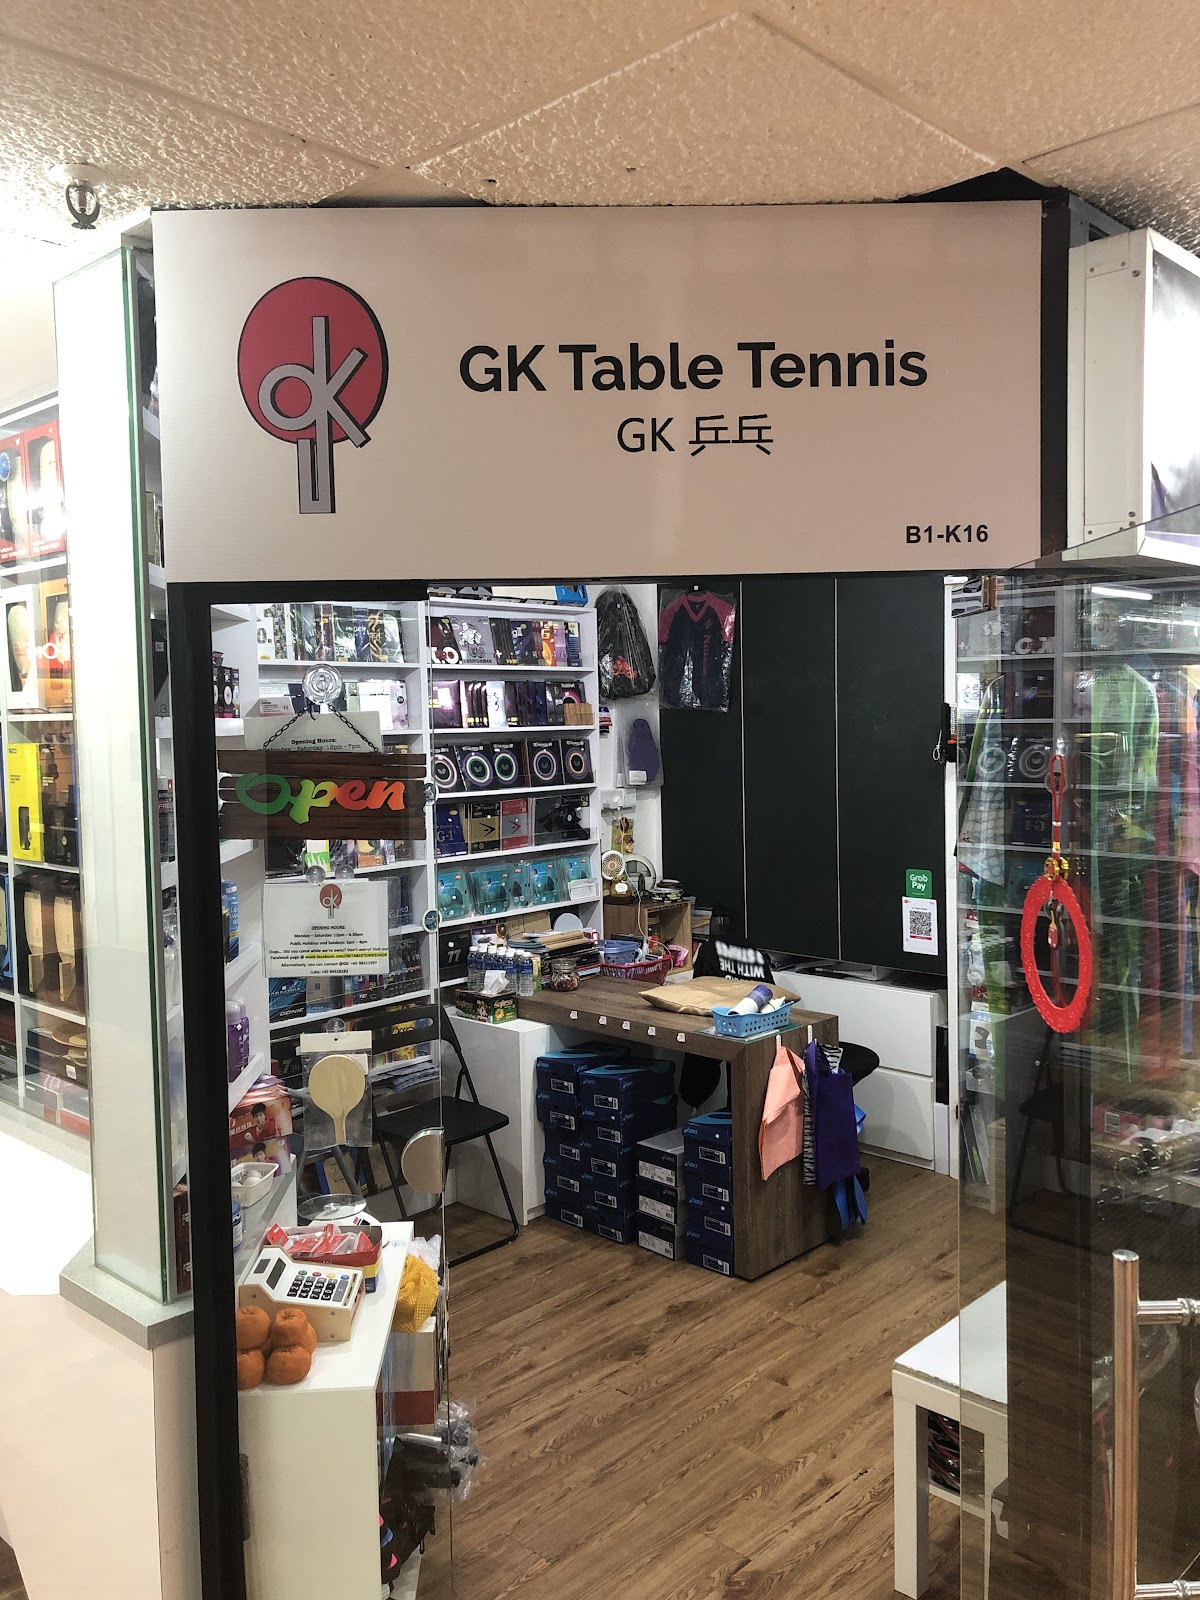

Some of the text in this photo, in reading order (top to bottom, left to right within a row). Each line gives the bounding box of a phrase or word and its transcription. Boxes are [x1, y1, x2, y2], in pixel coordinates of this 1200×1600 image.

[459, 338, 928, 393] GK Table Tennis
[617, 414, 775, 457] GK 乒乓
[905, 523, 990, 545] B1-K16
[235, 772, 405, 825] Open
[909, 874, 928, 882] Grab
[911, 881, 926, 891] Pay
[719, 958, 736, 974] THE
[736, 963, 765, 979] WITH
